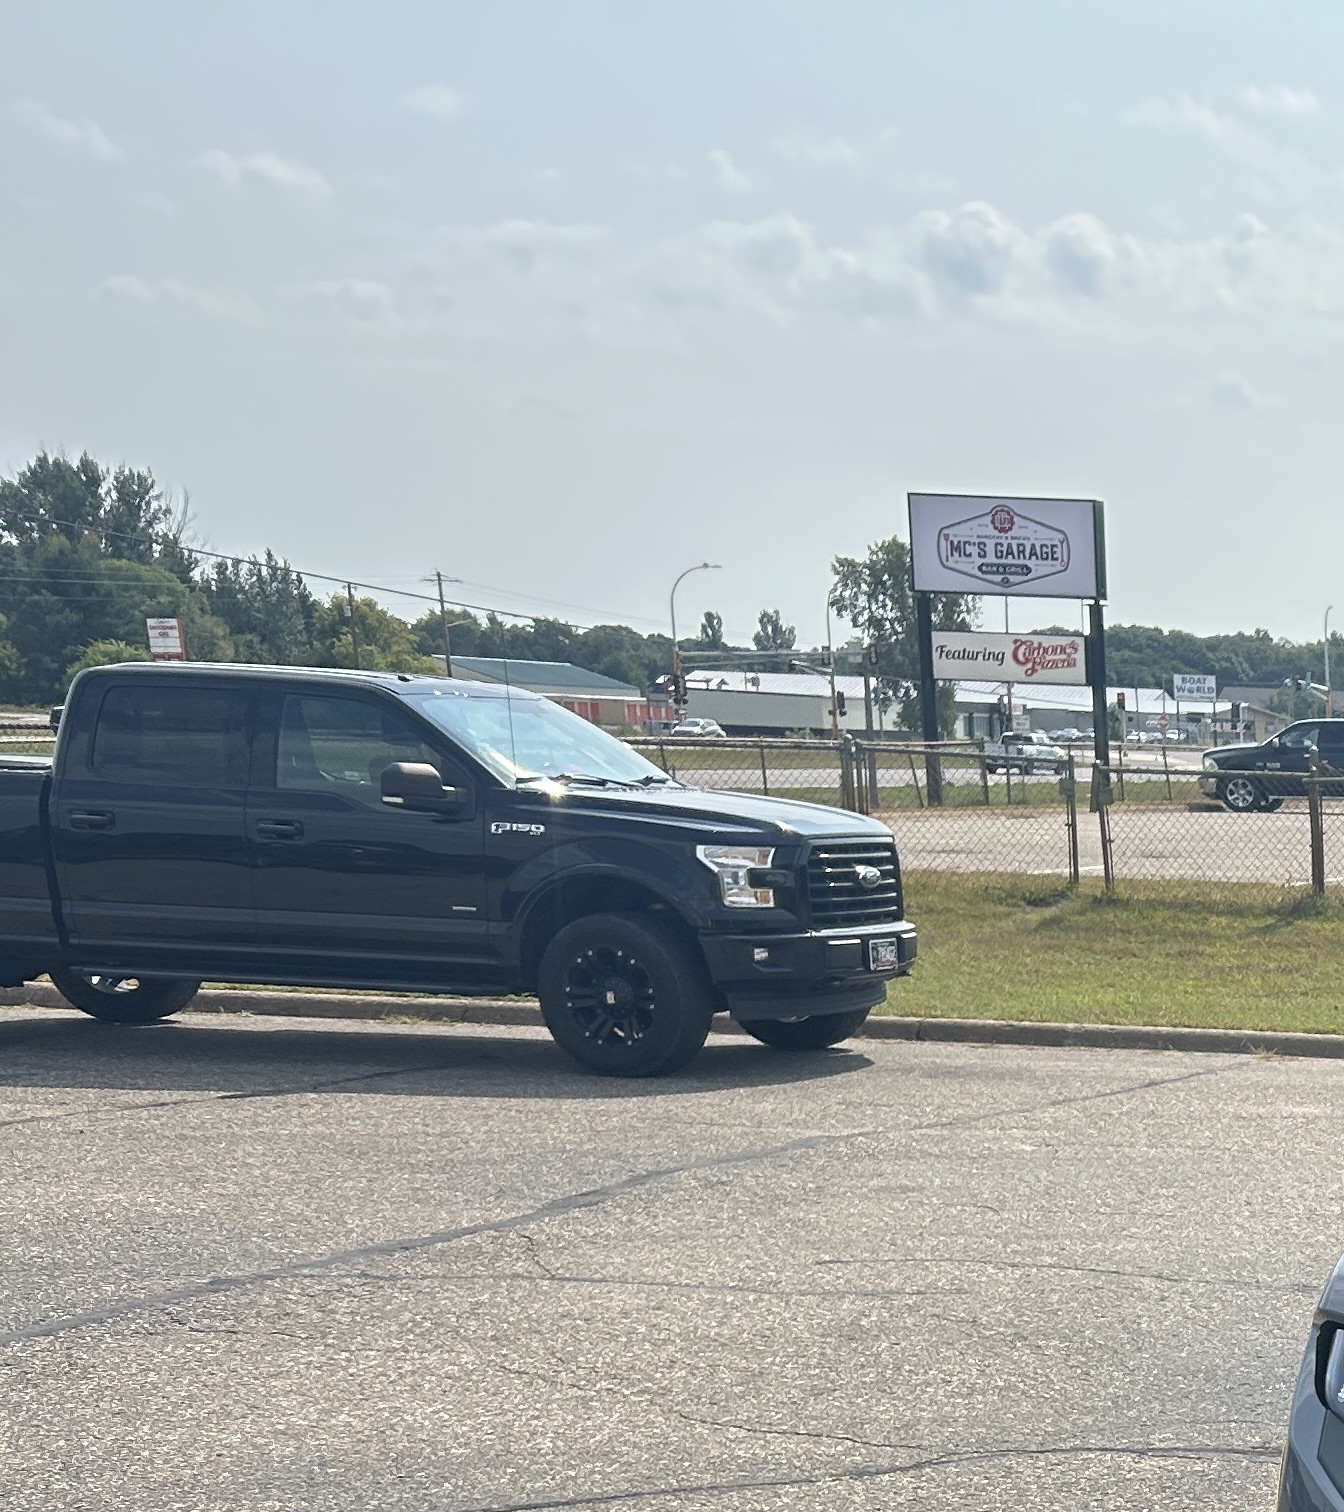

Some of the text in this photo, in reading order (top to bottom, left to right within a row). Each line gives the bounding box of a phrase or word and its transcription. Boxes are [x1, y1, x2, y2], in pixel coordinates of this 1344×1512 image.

[949, 539, 1060, 562] MC'S GARAGE
[935, 644, 1006, 667] Featuring
[1181, 676, 1208, 685] BOAT
